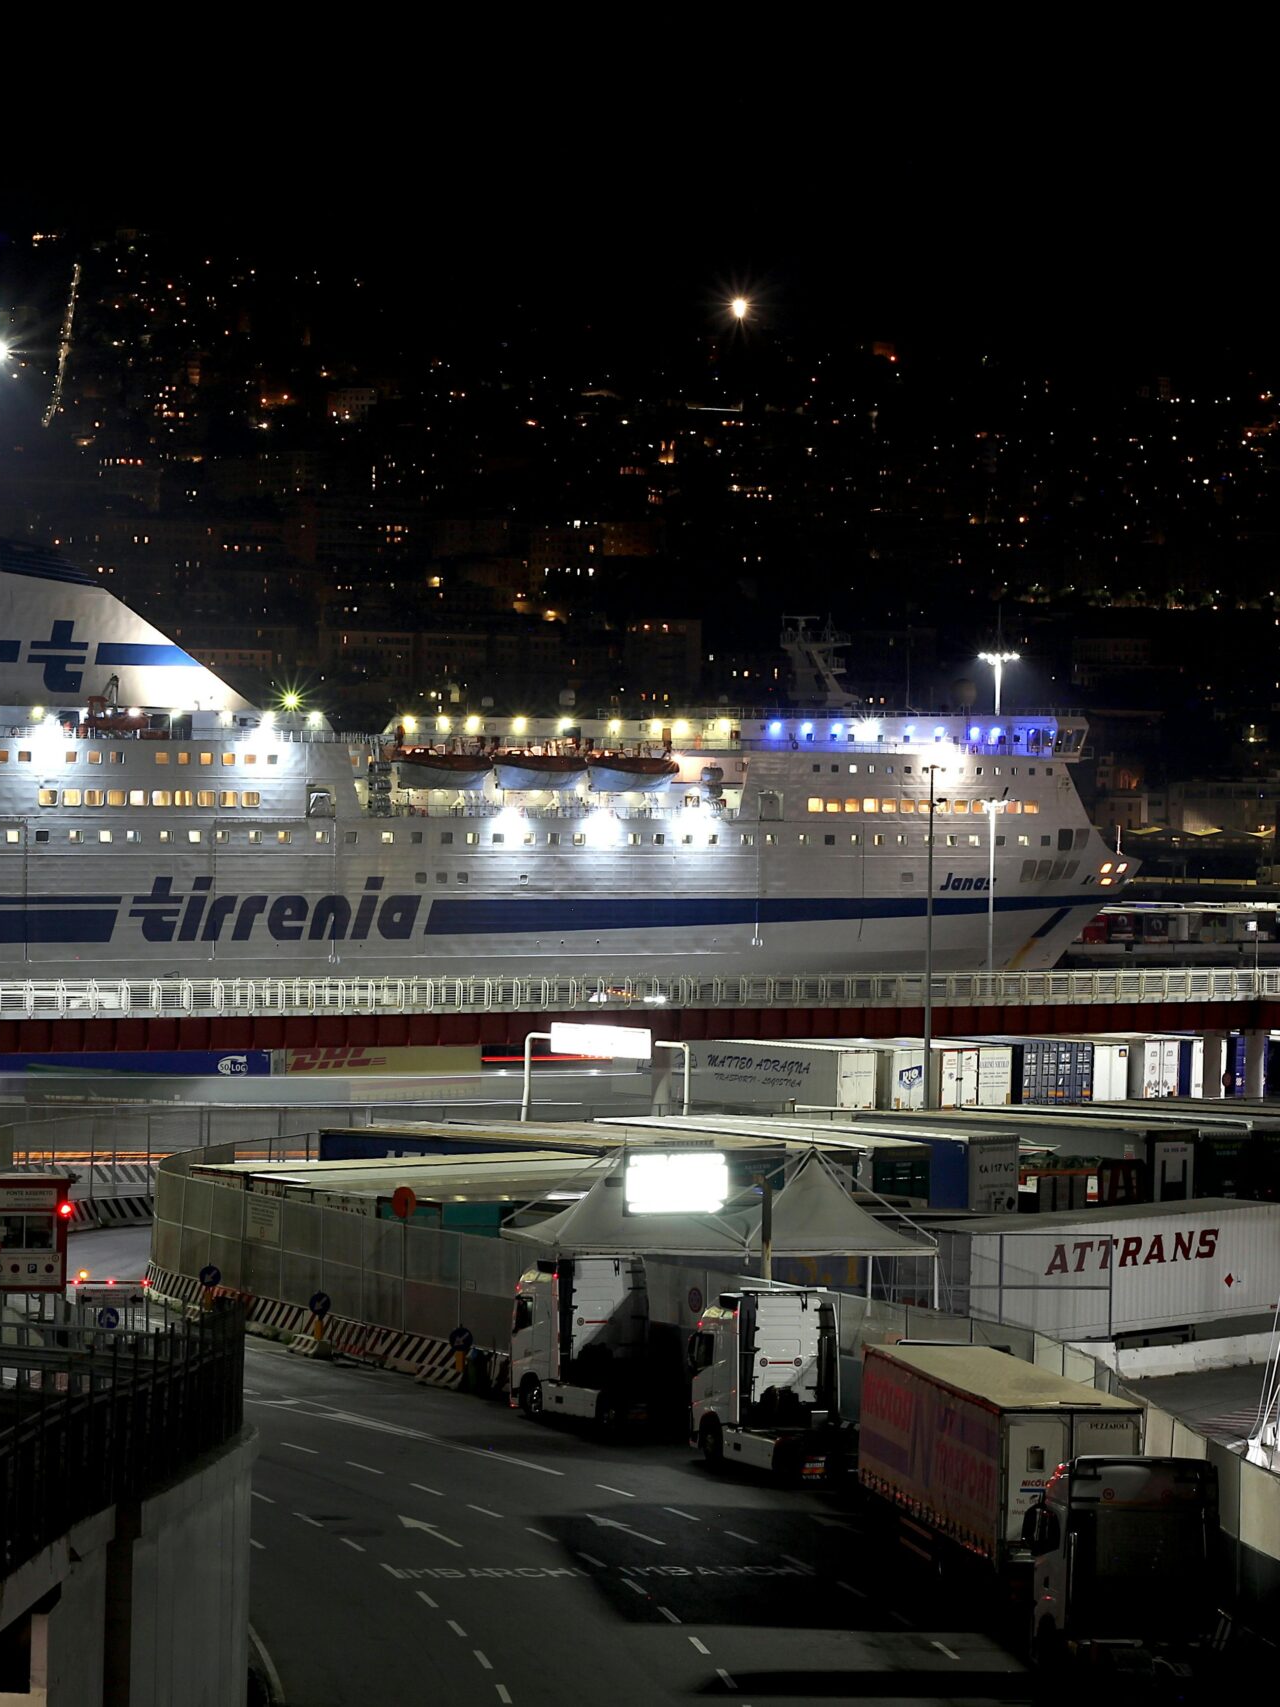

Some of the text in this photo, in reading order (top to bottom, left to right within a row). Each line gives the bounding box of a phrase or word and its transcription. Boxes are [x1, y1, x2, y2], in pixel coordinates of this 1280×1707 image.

[128, 876, 422, 943] tirrenia
[290, 1048, 372, 1072] DHL
[707, 1054, 811, 1075] MATTEO ADRAGNA
[1044, 1228, 1220, 1276] ATTRANS
